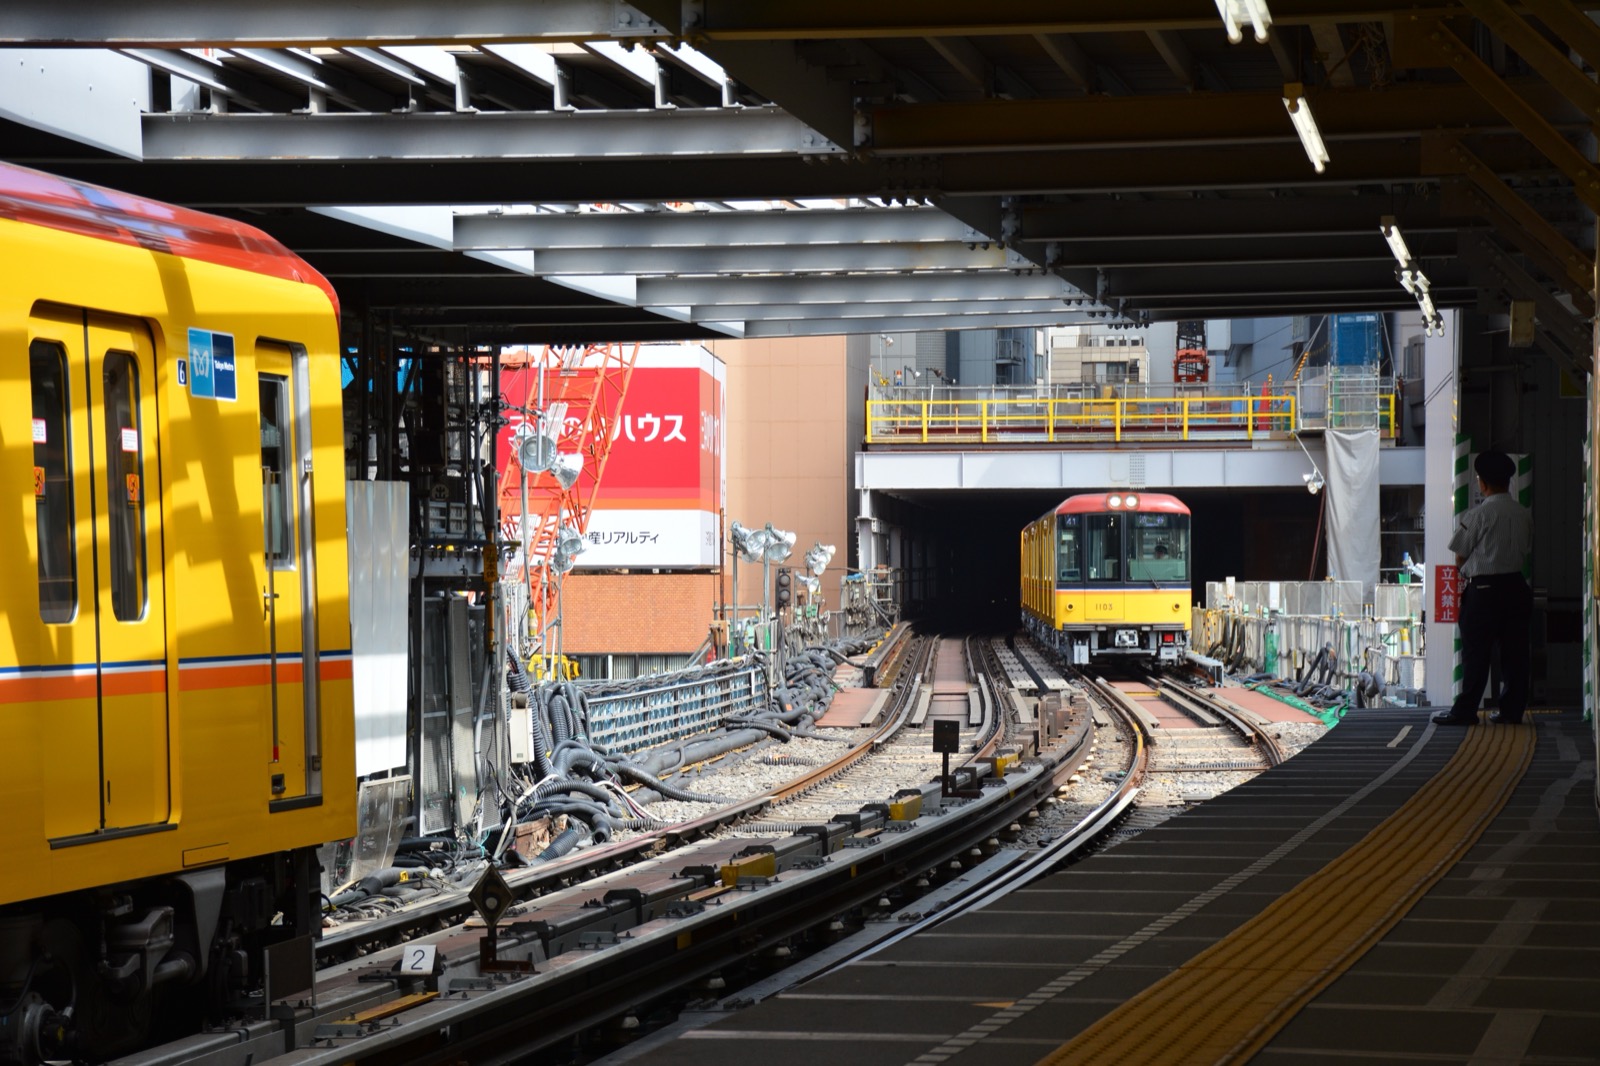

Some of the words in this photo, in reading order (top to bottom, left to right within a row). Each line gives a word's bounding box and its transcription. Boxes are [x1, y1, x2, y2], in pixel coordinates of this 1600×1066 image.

[179, 362, 186, 383] 6
[582, 531, 660, 545] 産リアルティ
[1441, 567, 1455, 621] 立入禁止
[1095, 602, 1113, 611] 1103
[410, 949, 425, 970] 2
